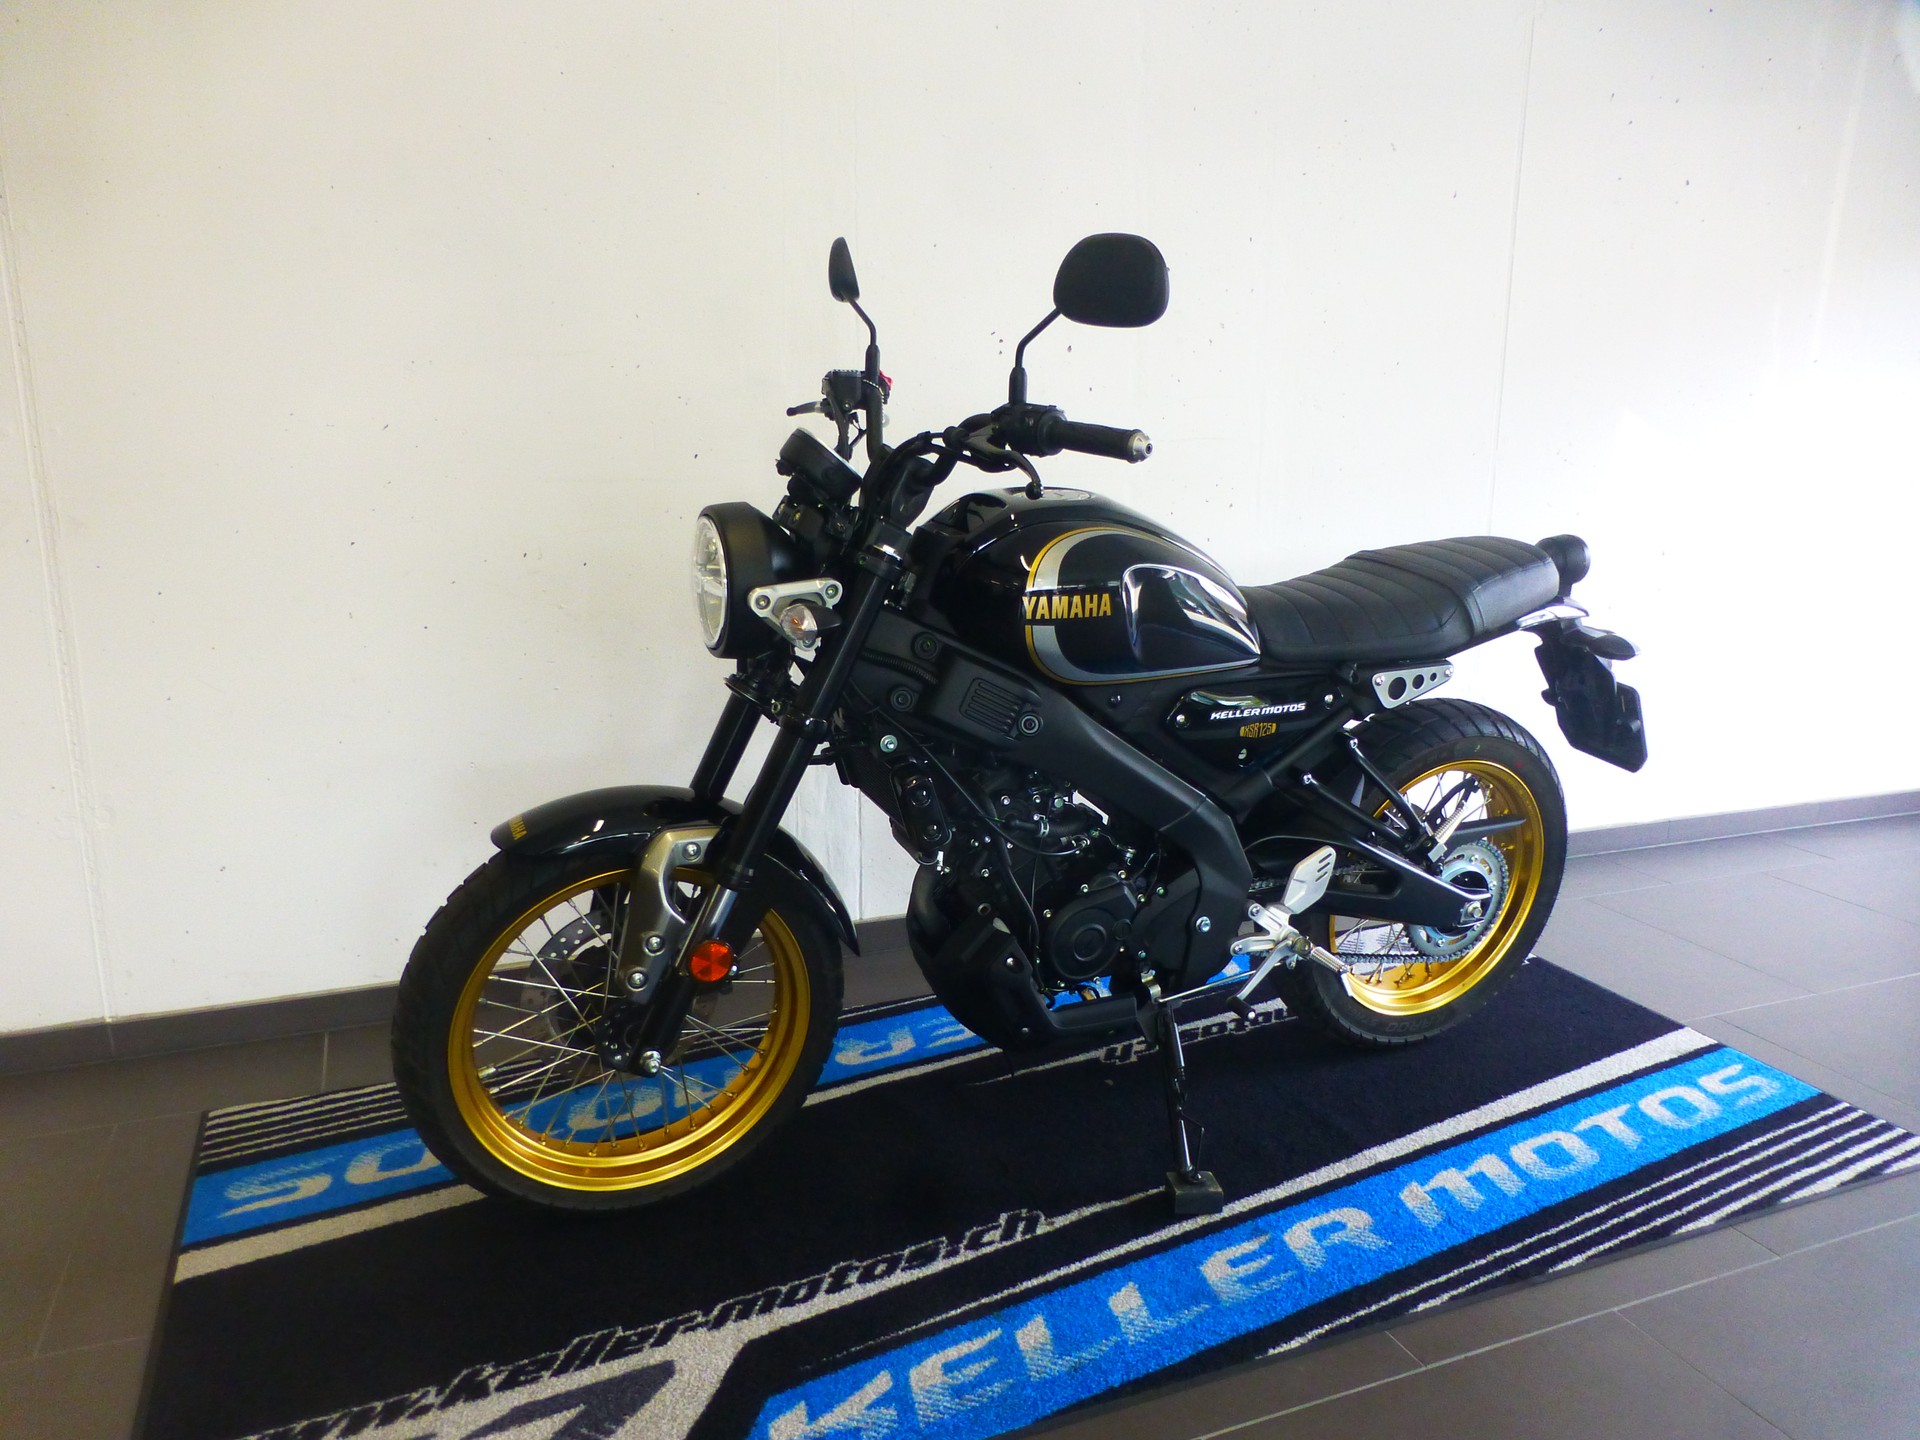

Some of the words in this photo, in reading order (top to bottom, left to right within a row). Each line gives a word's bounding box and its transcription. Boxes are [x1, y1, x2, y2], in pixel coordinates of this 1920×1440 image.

[1022, 593, 1111, 620] YAMAHA
[1210, 707, 1261, 720] KELLER
[1261, 702, 1307, 715] MOTOS
[1243, 722, 1272, 738] XSR125
[767, 1206, 1393, 1440] KELLER
[1399, 1063, 1782, 1231] MOTOS
[235, 1207, 1047, 1440] ww.keller-motos.ch
